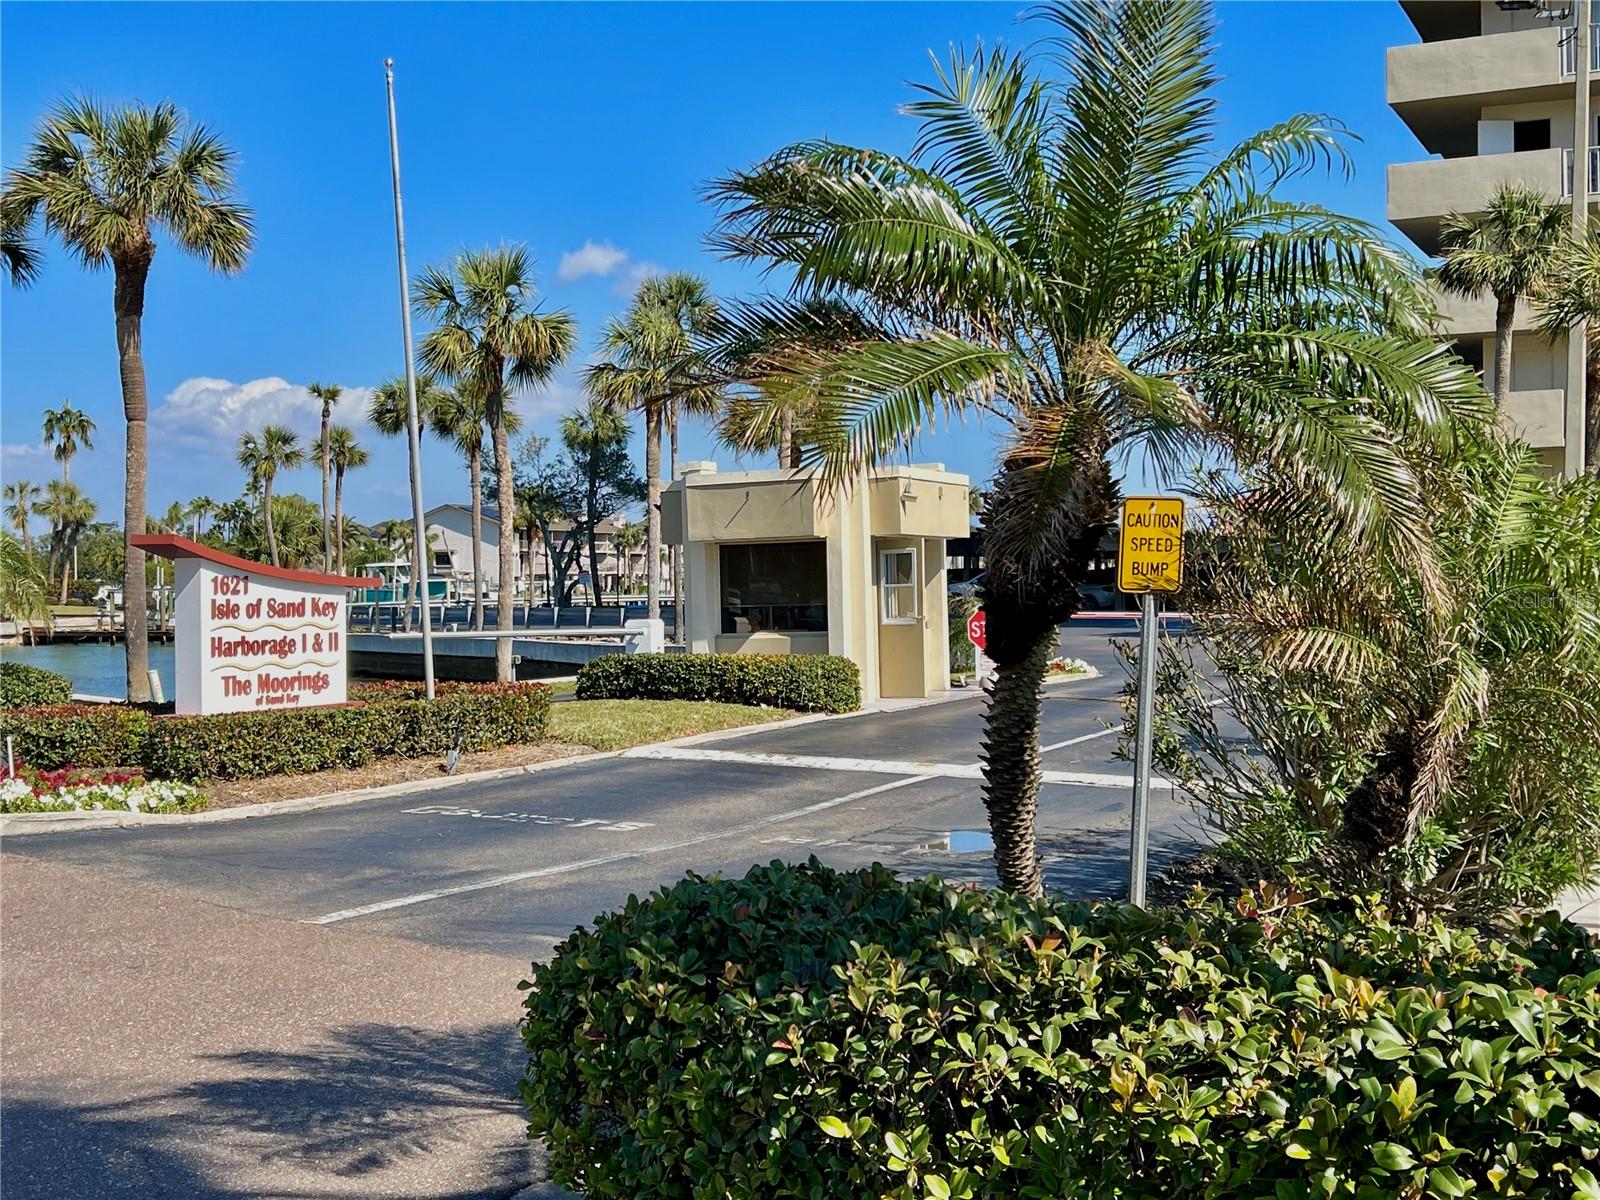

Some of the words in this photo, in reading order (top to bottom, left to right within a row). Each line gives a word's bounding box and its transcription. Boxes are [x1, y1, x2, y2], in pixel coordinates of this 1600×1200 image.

[1127, 513, 1180, 528] CAUTION
[1130, 537, 1173, 552] SPEED
[1131, 561, 1169, 577] BUMP
[210, 575, 249, 596] 1621
[210, 598, 241, 620] Isle
[245, 598, 262, 619] of
[266, 597, 306, 618] Sand
[310, 597, 339, 621] Key
[971, 621, 987, 638] ST
[210, 635, 297, 659] Harborage
[301, 633, 308, 653] I
[312, 633, 324, 653] &
[328, 632, 339, 652] II
[221, 675, 252, 697] The
[257, 671, 330, 694] Moorings
[255, 696, 264, 706] of
[265, 694, 285, 705] Sand
[286, 693, 301, 705] Key
